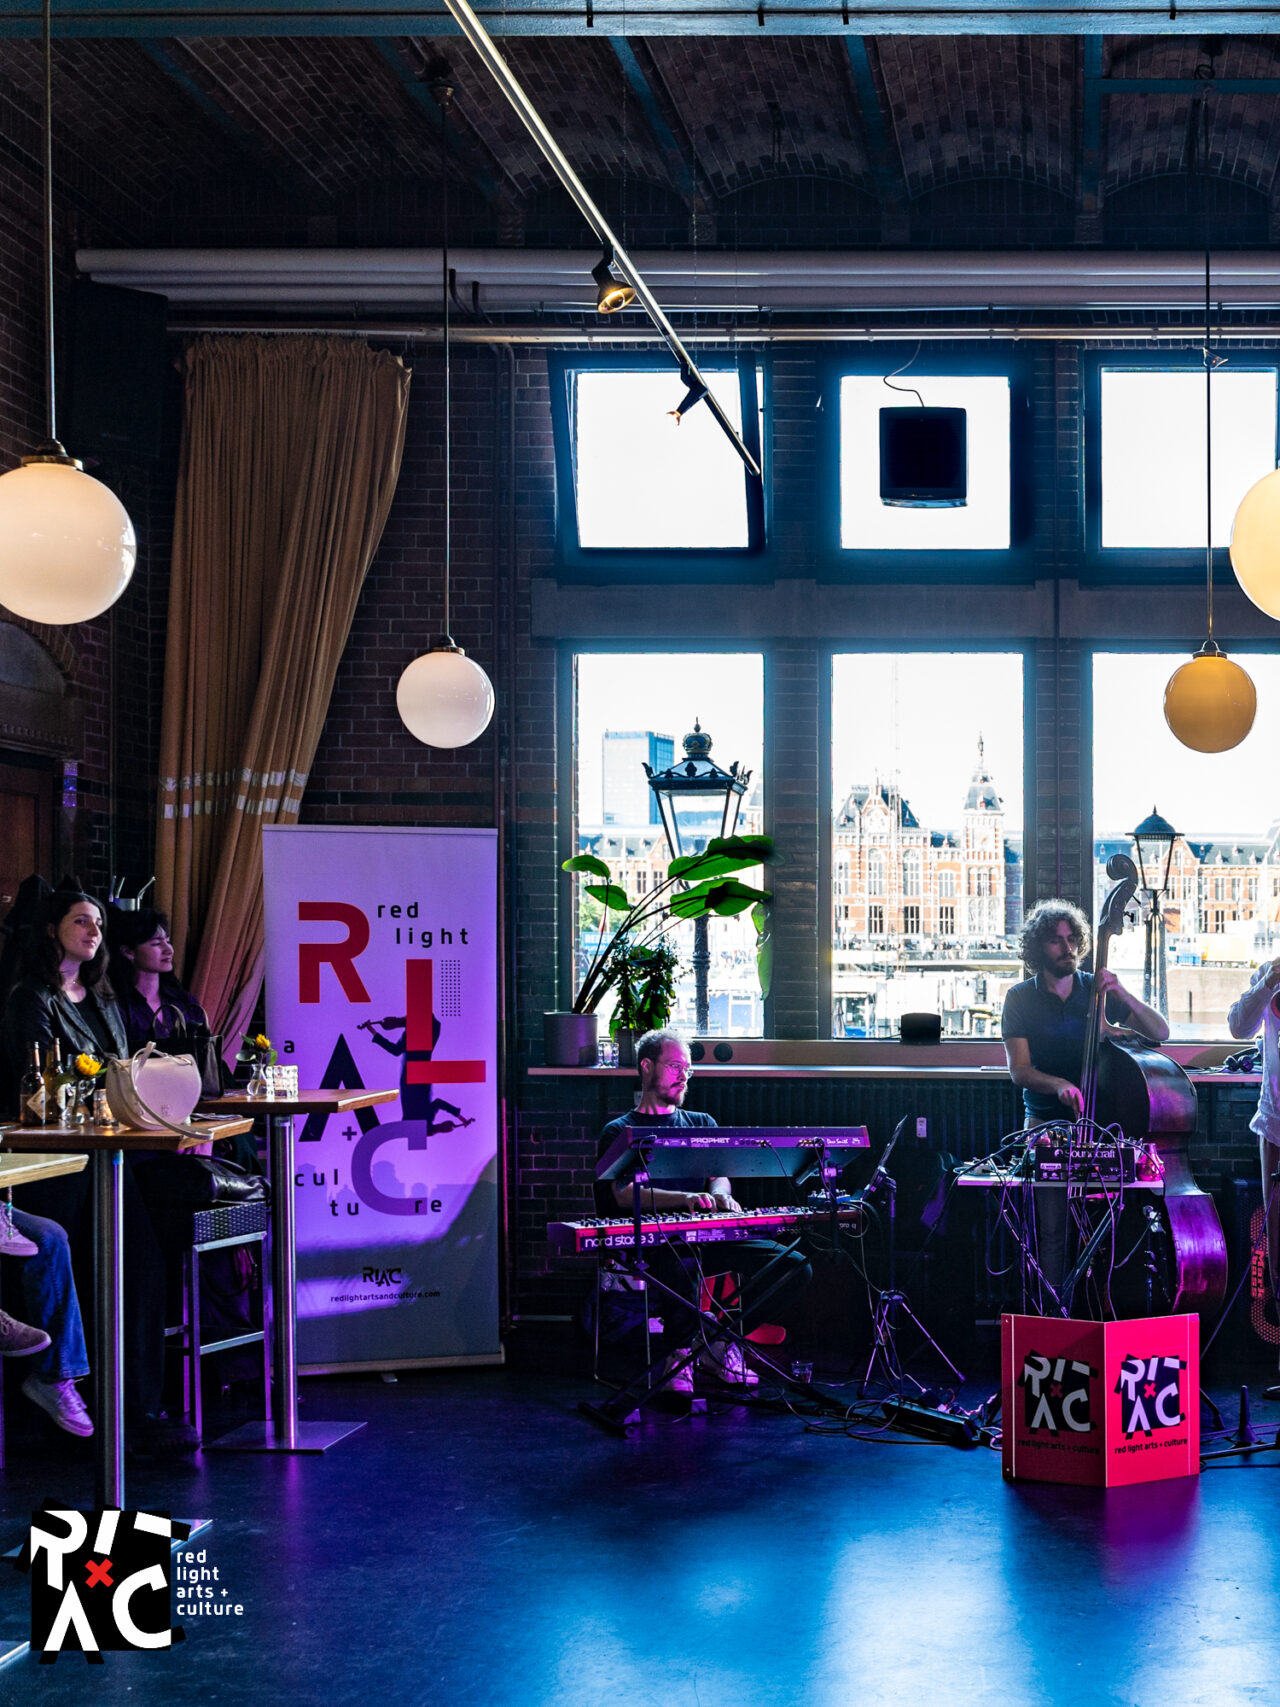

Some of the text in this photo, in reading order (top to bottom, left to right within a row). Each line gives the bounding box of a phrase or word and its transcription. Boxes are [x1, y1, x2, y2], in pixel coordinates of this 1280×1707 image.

[377, 901, 419, 919] red
[395, 926, 469, 949] light
[294, 1168, 340, 1187] cul
[330, 1199, 360, 1216] tu
[413, 1198, 443, 1214] re
[647, 1233, 655, 1244] 3
[330, 1291, 441, 1303] redlightartsandculture.com
[1114, 1445, 1127, 1455] red
[1127, 1443, 1143, 1454] light
[1144, 1441, 1158, 1450] arts
[1164, 1437, 1188, 1448] culture
